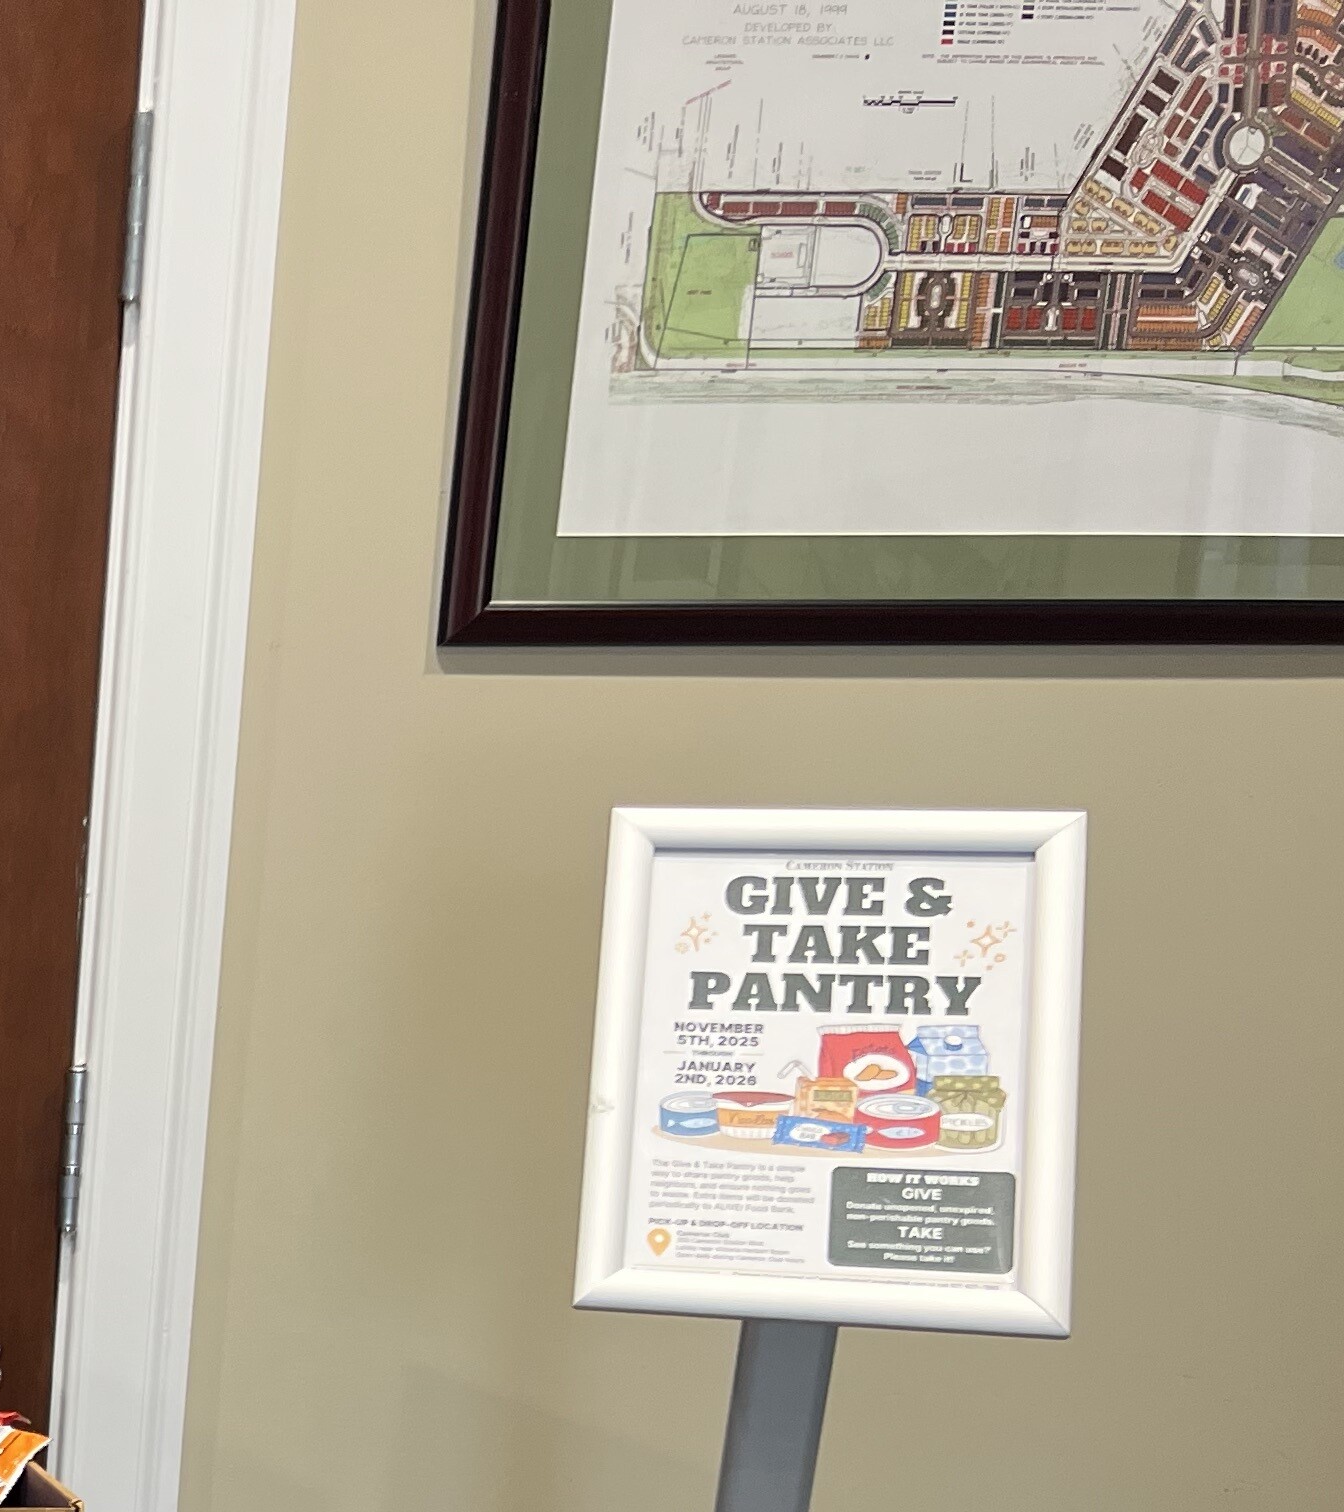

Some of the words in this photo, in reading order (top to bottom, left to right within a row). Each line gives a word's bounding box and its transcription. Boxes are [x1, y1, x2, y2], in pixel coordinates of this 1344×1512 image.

[733, 4, 787, 15] AUGUST
[820, 4, 847, 15] 1999
[744, 23, 811, 32] DEVELOPED
[816, 23, 832, 32] BY
[682, 36, 737, 45] CAMERON
[743, 36, 791, 45] STATION
[797, 36, 867, 45] ASSOCIATES
[725, 875, 884, 916] GIVE
[904, 877, 952, 918] &
[743, 925, 930, 965] TAKE
[689, 971, 981, 1016] PANTRY
[674, 1021, 763, 1034] NOVEMBER
[677, 1035, 714, 1049] 5TH,
[718, 1036, 758, 1047] 2025
[677, 1060, 756, 1073] JANUARY
[674, 1073, 711, 1087] 2ND,
[716, 1074, 757, 1086] 2026
[902, 1188, 942, 1200] GIVE
[898, 1226, 943, 1239] TAKE
